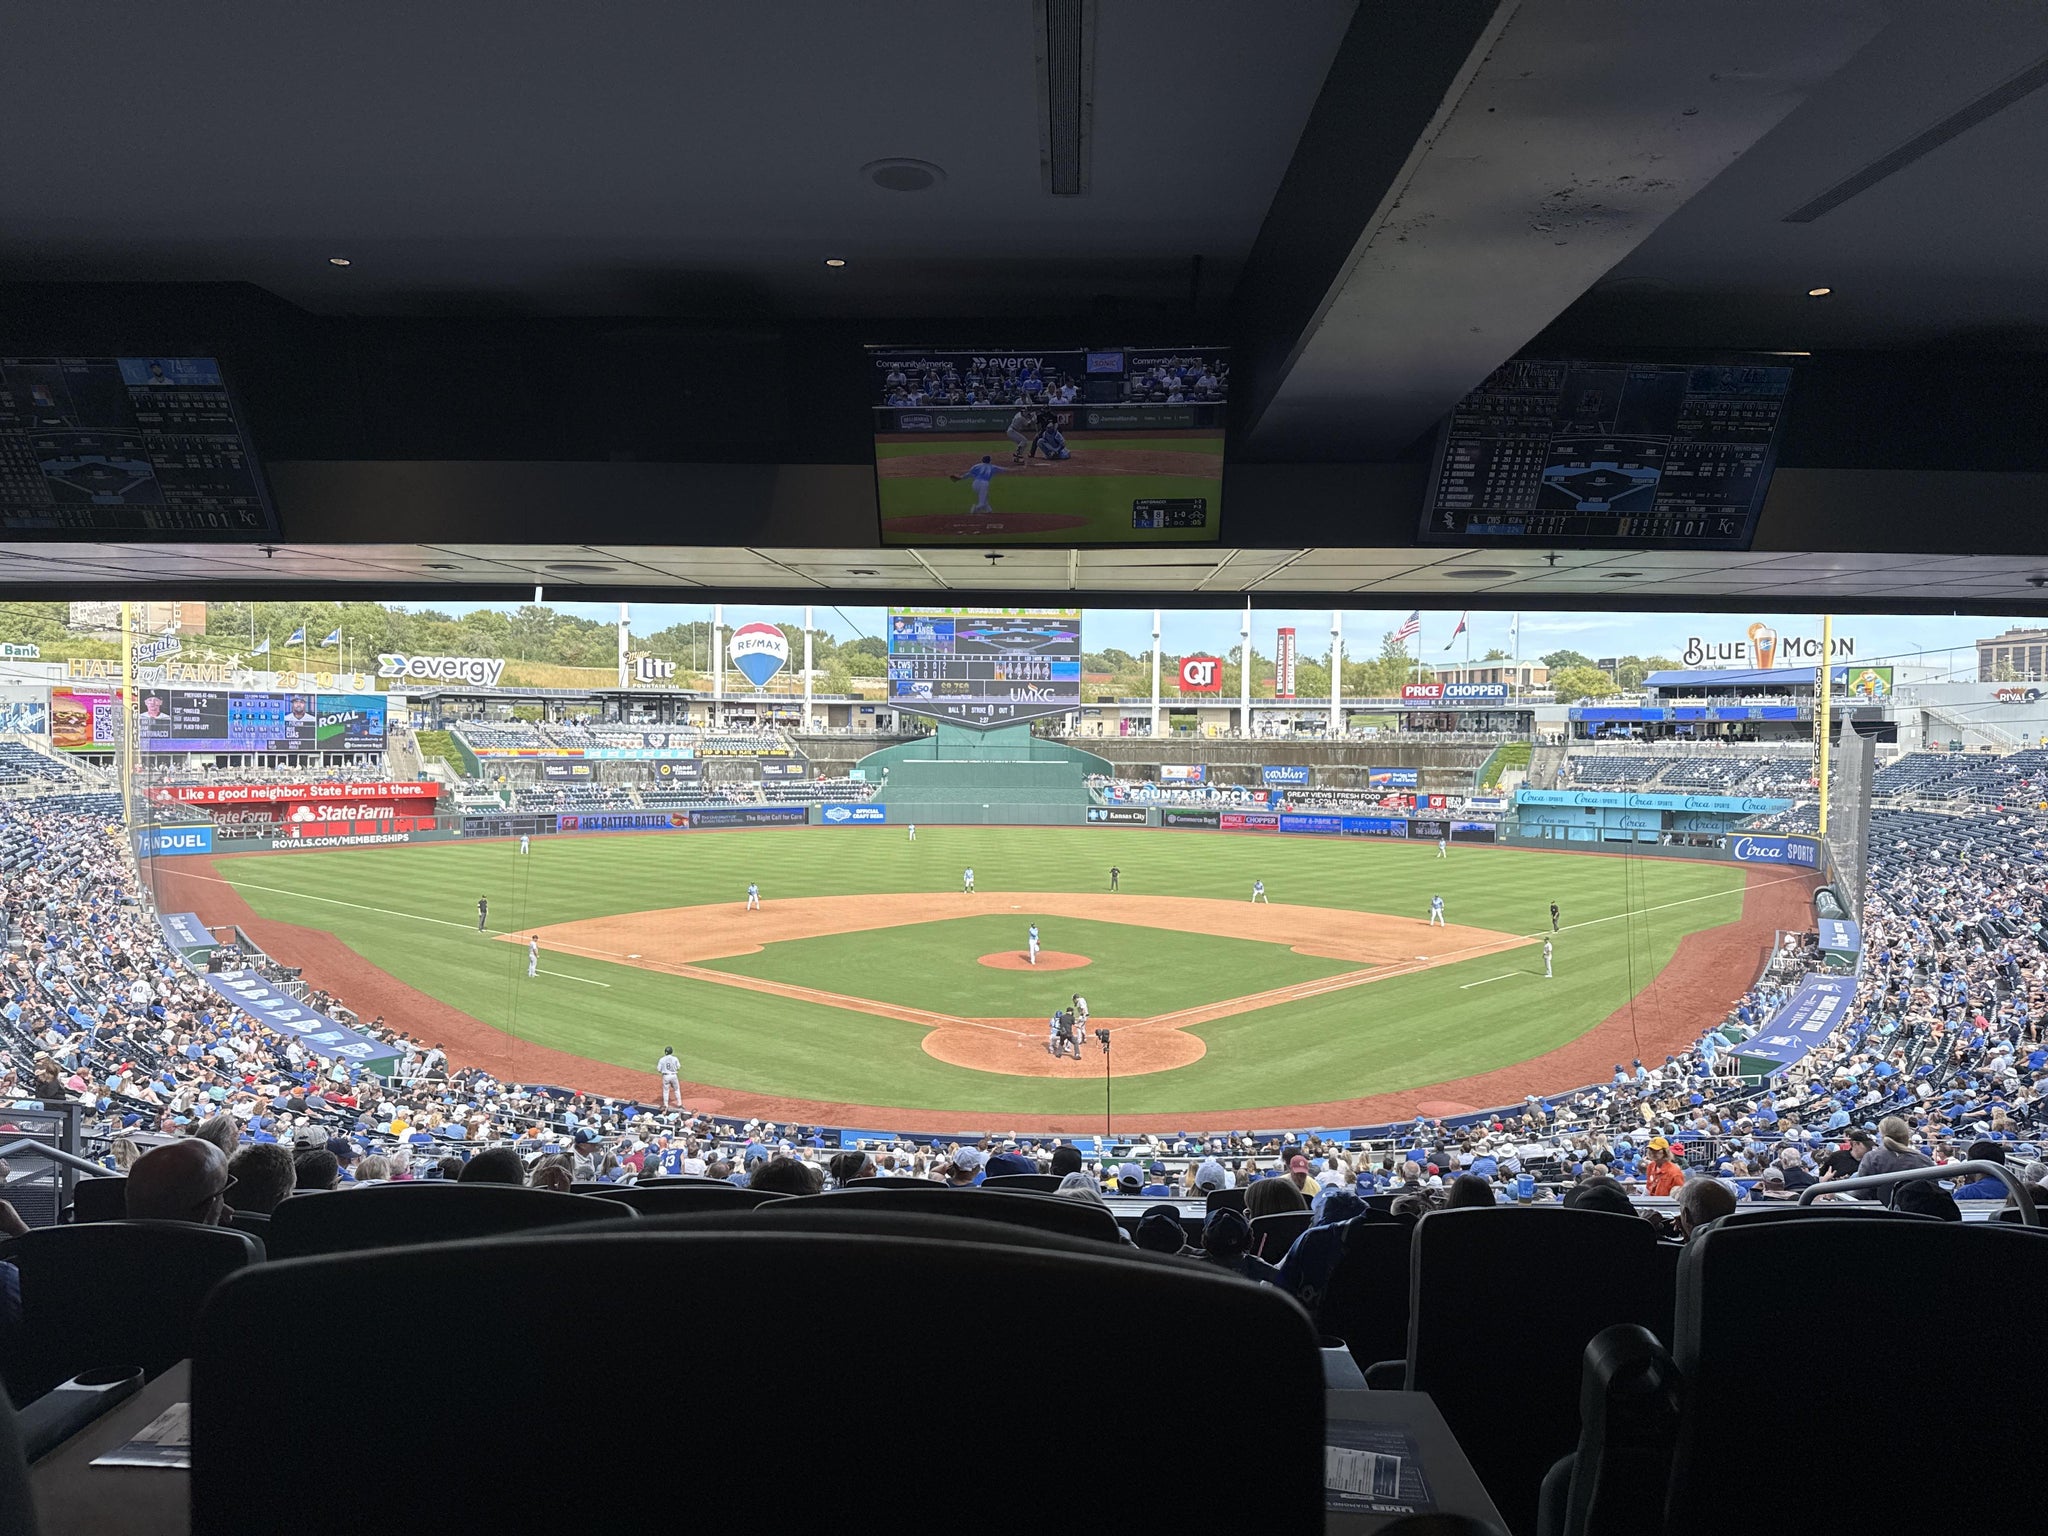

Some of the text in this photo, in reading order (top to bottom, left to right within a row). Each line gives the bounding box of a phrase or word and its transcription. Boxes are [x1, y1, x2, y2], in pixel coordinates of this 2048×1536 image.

[4, 644, 38, 657] Bank
[738, 639, 781, 651] RE/MAX
[1683, 637, 1745, 666] BLUE
[143, 665, 160, 681] of
[166, 663, 232, 682] FAME
[412, 659, 502, 683] evergy
[635, 657, 677, 683] Lite
[1183, 660, 1216, 686] QT
[277, 671, 299, 688] 20
[316, 671, 333, 688] 10
[353, 673, 366, 690] 5
[1010, 688, 1055, 702] UMKC
[1405, 685, 1504, 697] PRICE CHOPPER
[1999, 692, 2035, 702] RIVALS
[319, 710, 359, 728] ROYAL
[1265, 767, 1306, 779] carbliss
[178, 784, 424, 801] Like a good neighbor, State Farm is there.
[1212, 790, 1252, 802] DECK
[1310, 791, 1332, 799] VIEWS
[1336, 792, 1359, 800] FRESH
[1521, 791, 1545, 803] Circa
[1574, 793, 1599, 805] Circa
[1430, 797, 1443, 806] QT
[1628, 795, 1653, 807] Circa
[1684, 796, 1711, 810] Circa
[1742, 798, 1768, 812] Circa
[583, 817, 600, 829] HEY
[602, 816, 635, 829] BATTER
[636, 815, 667, 828] BATTER
[757, 814, 771, 822] Right
[772, 813, 781, 821] Call
[1110, 811, 1146, 820] Kansas City
[1224, 815, 1243, 823] PRICE
[1620, 815, 1647, 829] Circa
[272, 834, 410, 849] ROYALS.COM/MEMBERSHIPS
[1734, 837, 1814, 863] Circa SPORTS
[665, 1154, 676, 1167] 13
